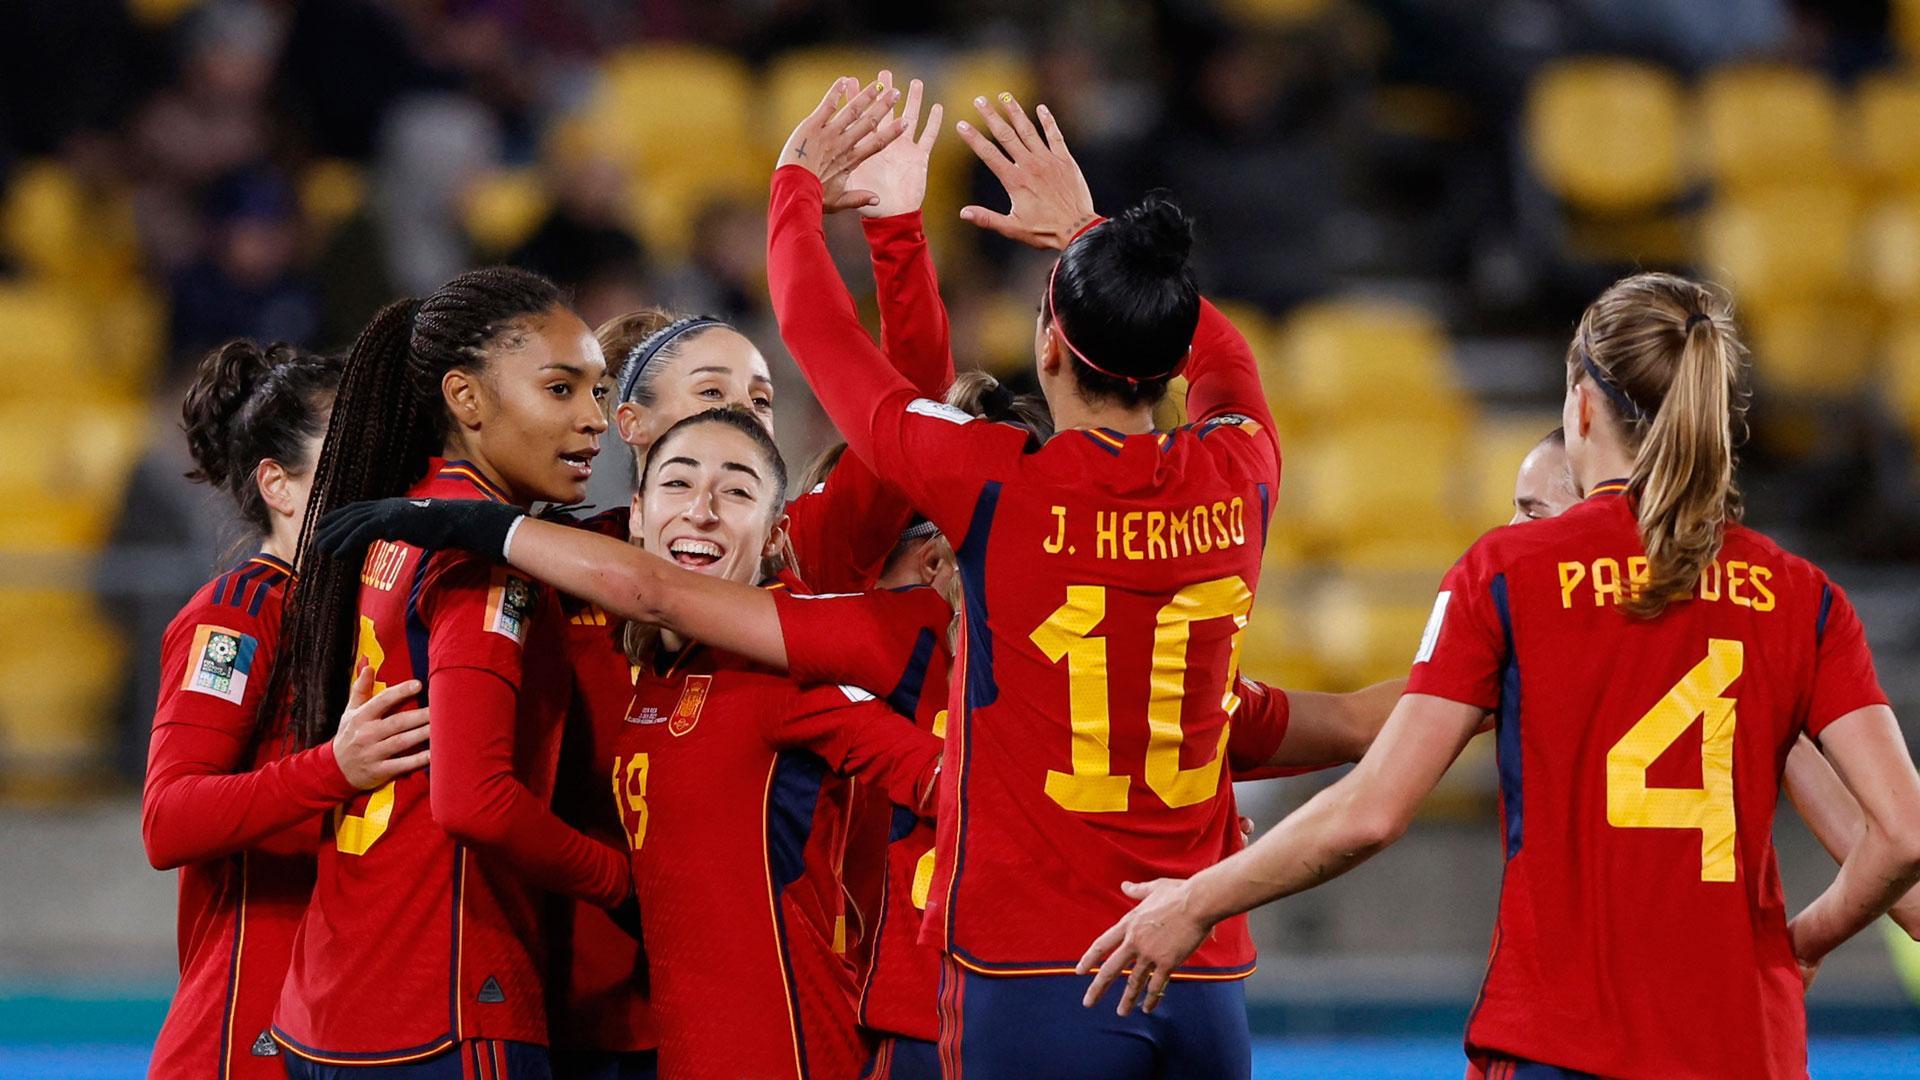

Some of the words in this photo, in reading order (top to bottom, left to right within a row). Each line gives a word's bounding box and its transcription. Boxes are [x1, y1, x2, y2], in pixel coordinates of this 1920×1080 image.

[1043, 505, 1076, 554] J.
[1096, 496, 1245, 560] HERMOSO
[1557, 555, 1776, 612] PARDES
[1029, 575, 1253, 812] 10
[1607, 637, 1743, 882] 4
